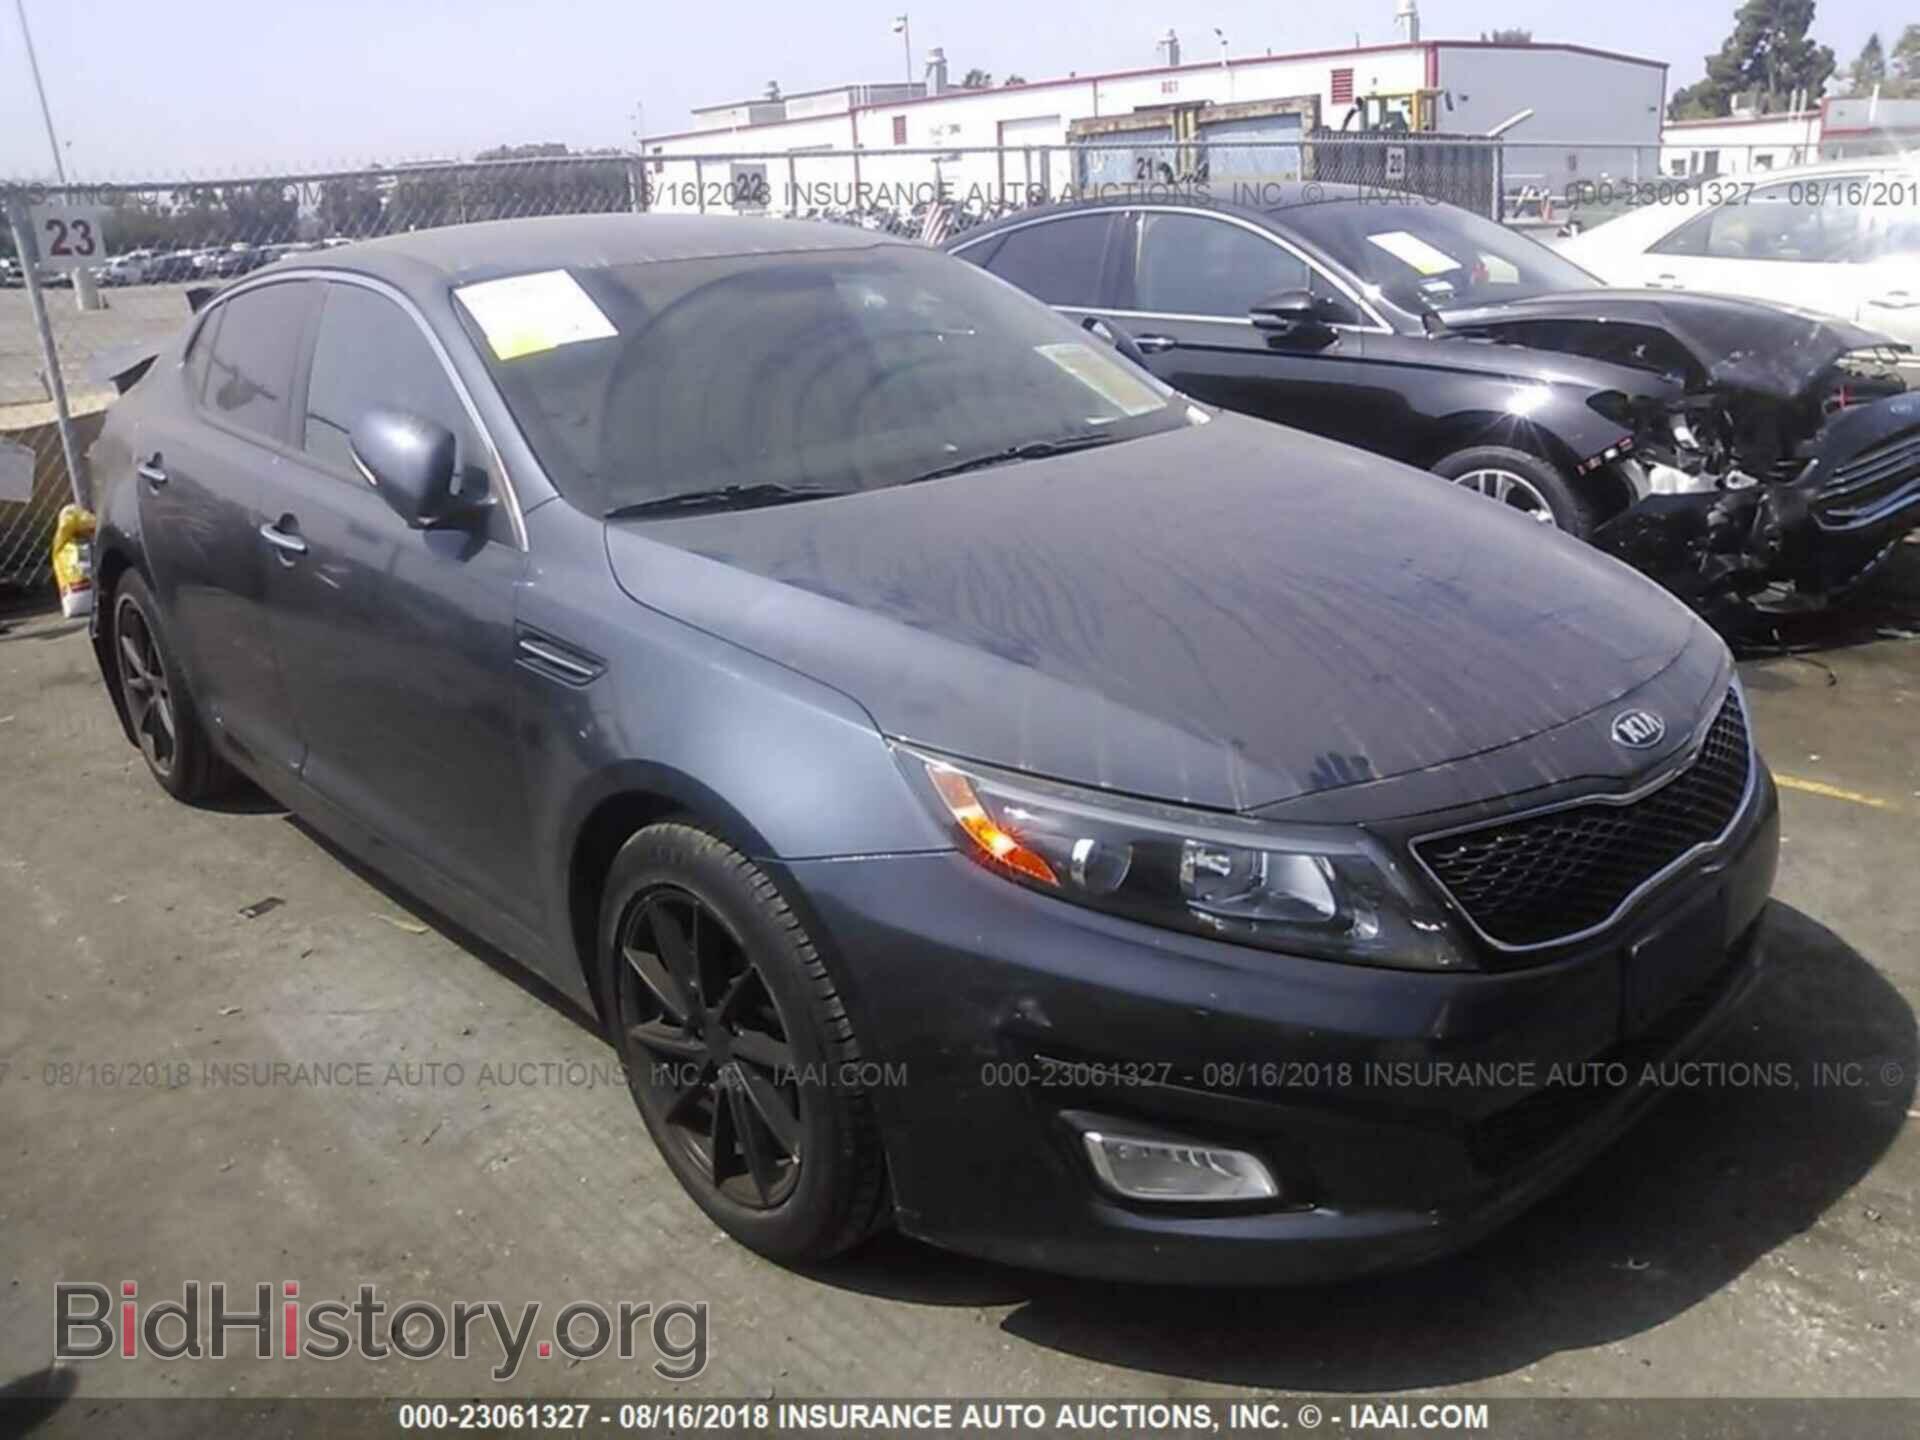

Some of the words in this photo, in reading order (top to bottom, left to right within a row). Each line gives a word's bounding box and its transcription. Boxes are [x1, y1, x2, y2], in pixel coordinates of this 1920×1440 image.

[1136, 158, 1153, 180] 21
[735, 172, 762, 200] 22
[45, 218, 96, 256] 23
[1617, 711, 1661, 743] KIA
